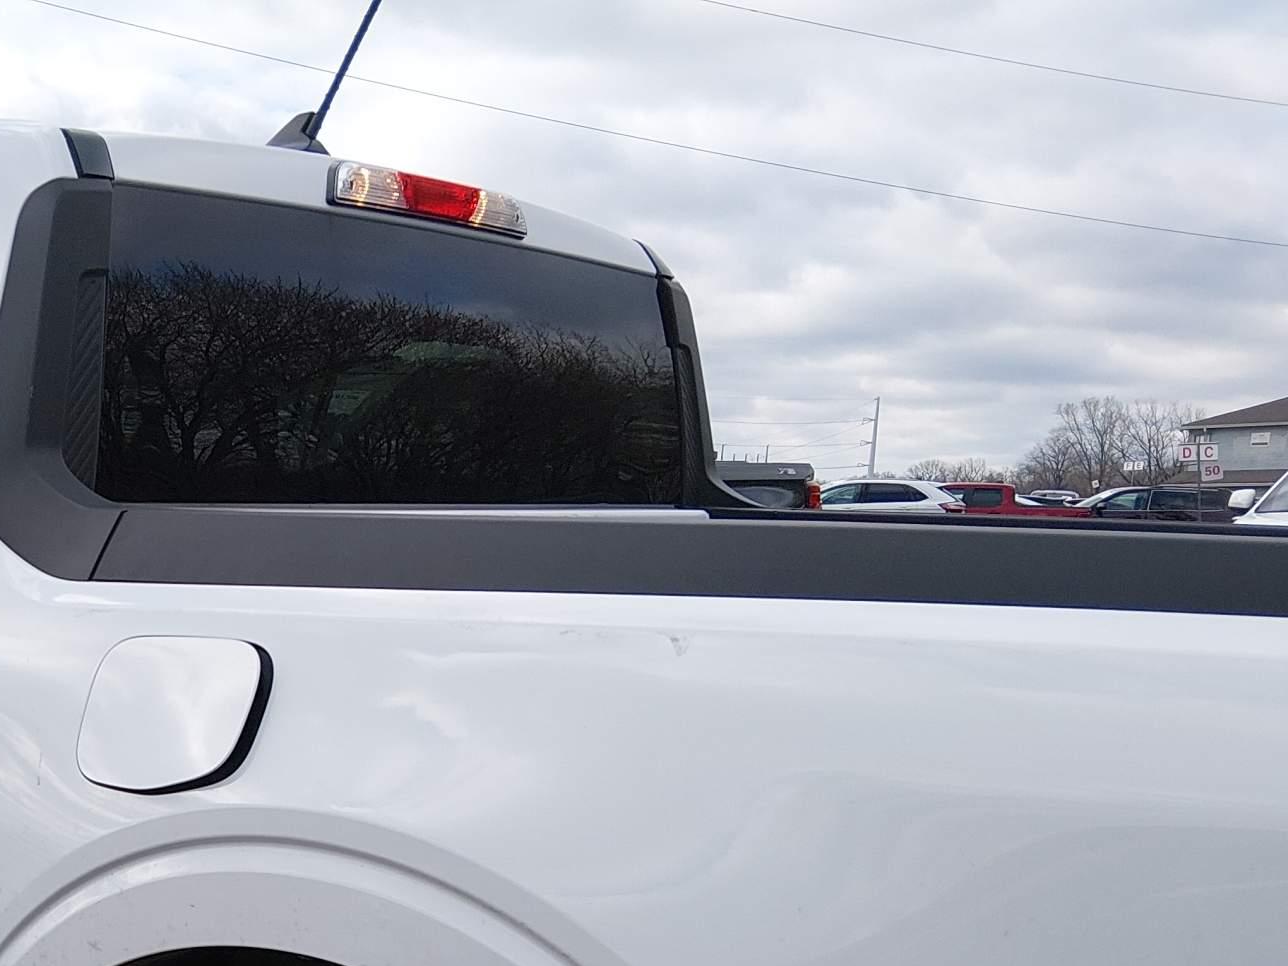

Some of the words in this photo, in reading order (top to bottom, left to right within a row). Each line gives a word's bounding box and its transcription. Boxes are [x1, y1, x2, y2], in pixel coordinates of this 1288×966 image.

[1182, 447, 1192, 459] D
[1204, 446, 1214, 458] C
[1204, 465, 1220, 477] 50
